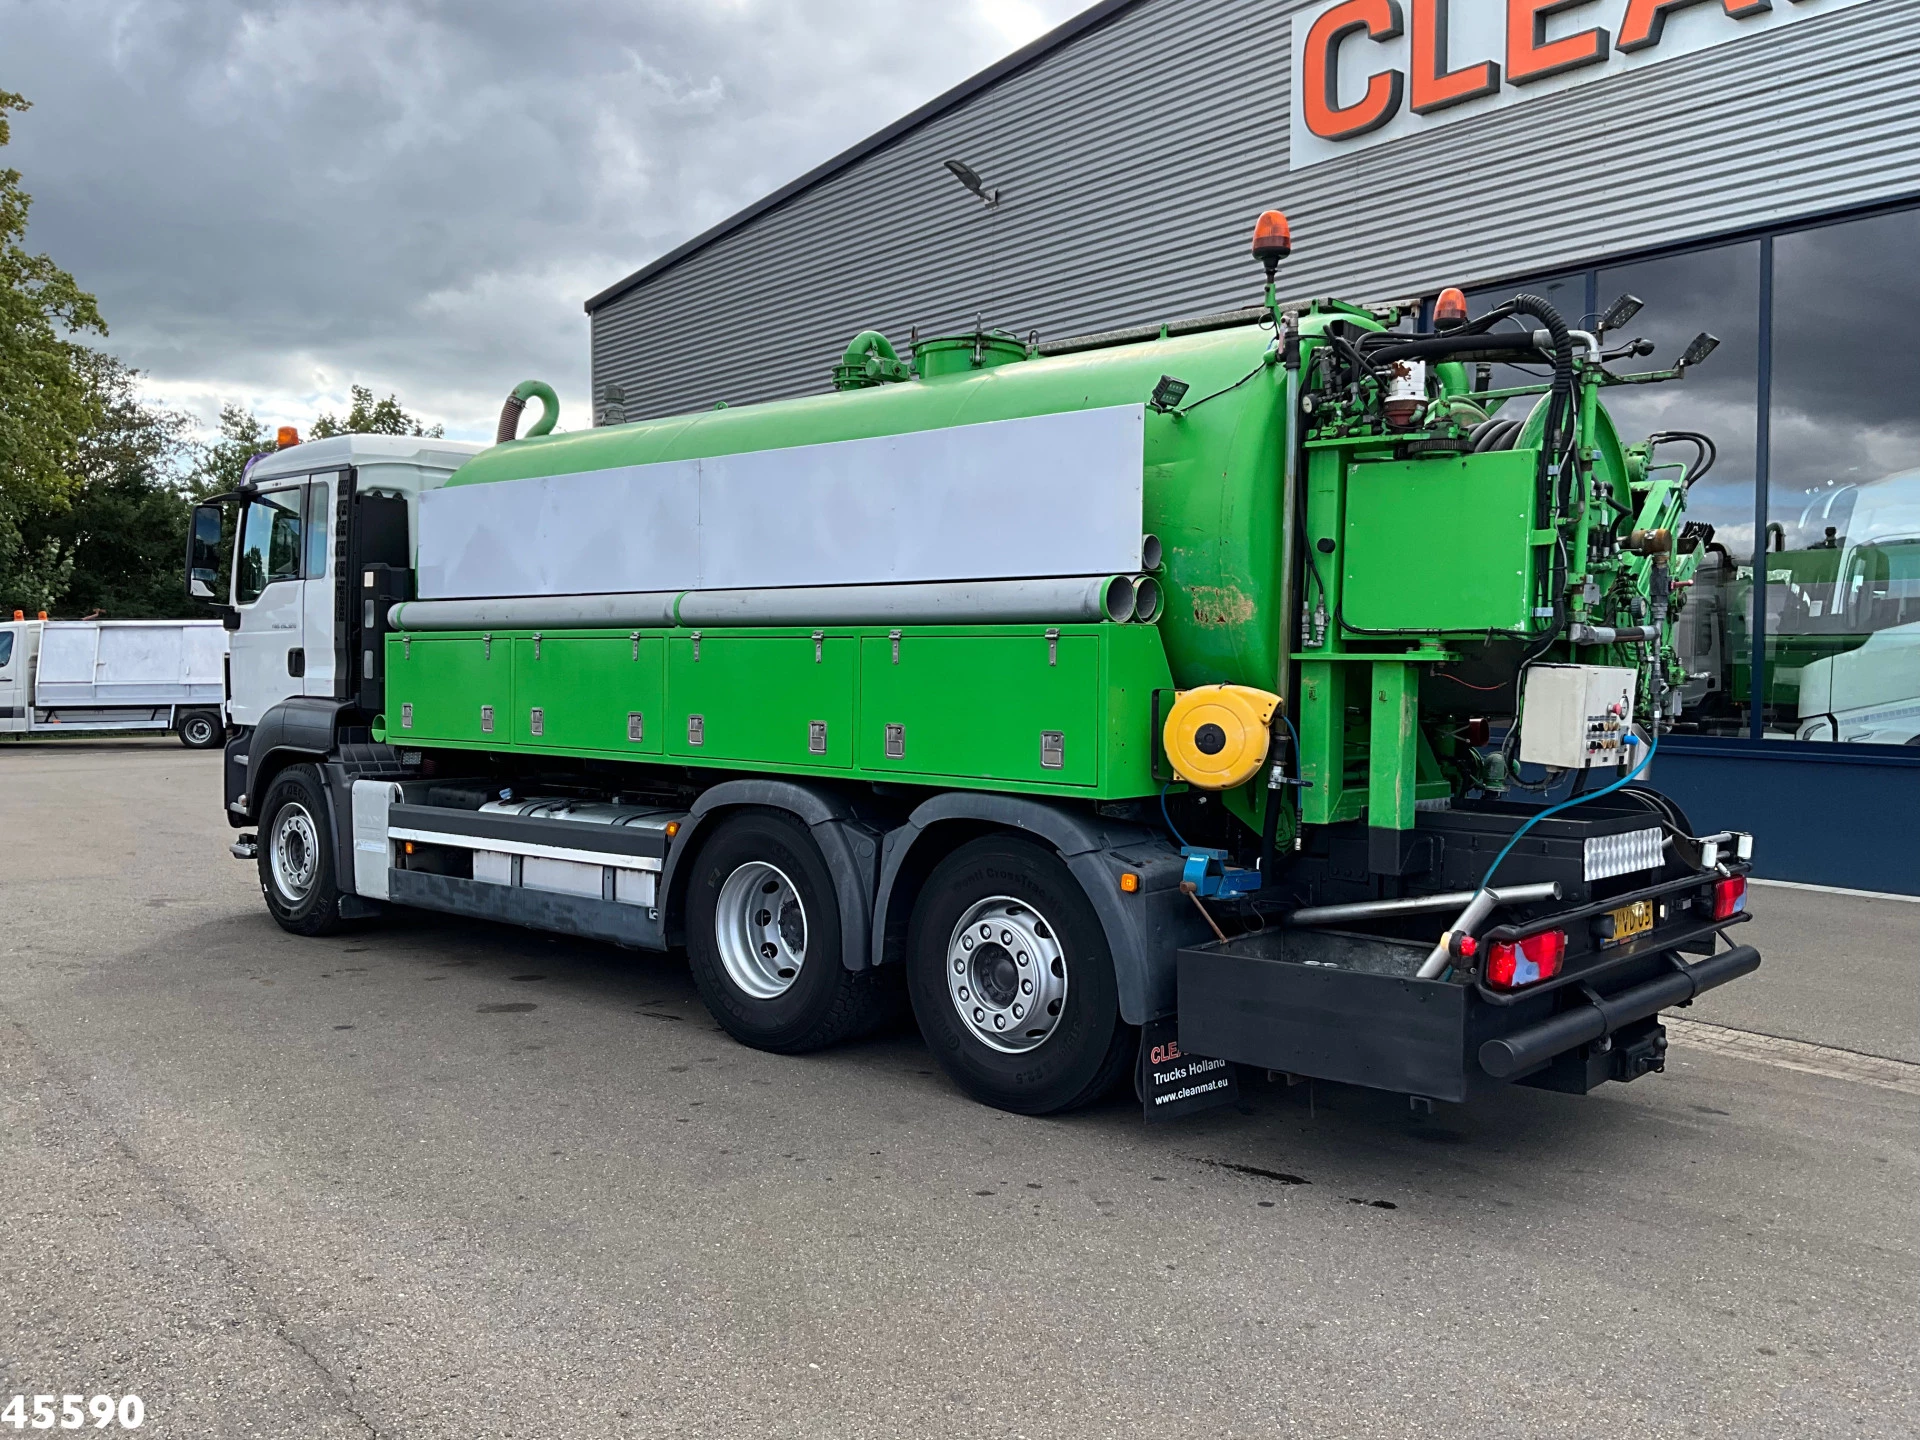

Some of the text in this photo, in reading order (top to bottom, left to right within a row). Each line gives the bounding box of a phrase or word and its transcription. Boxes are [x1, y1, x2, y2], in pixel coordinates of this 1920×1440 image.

[1153, 1059, 1226, 1085] Trucks Holland
[1154, 1078, 1229, 1106] www.cleanmat.eu
